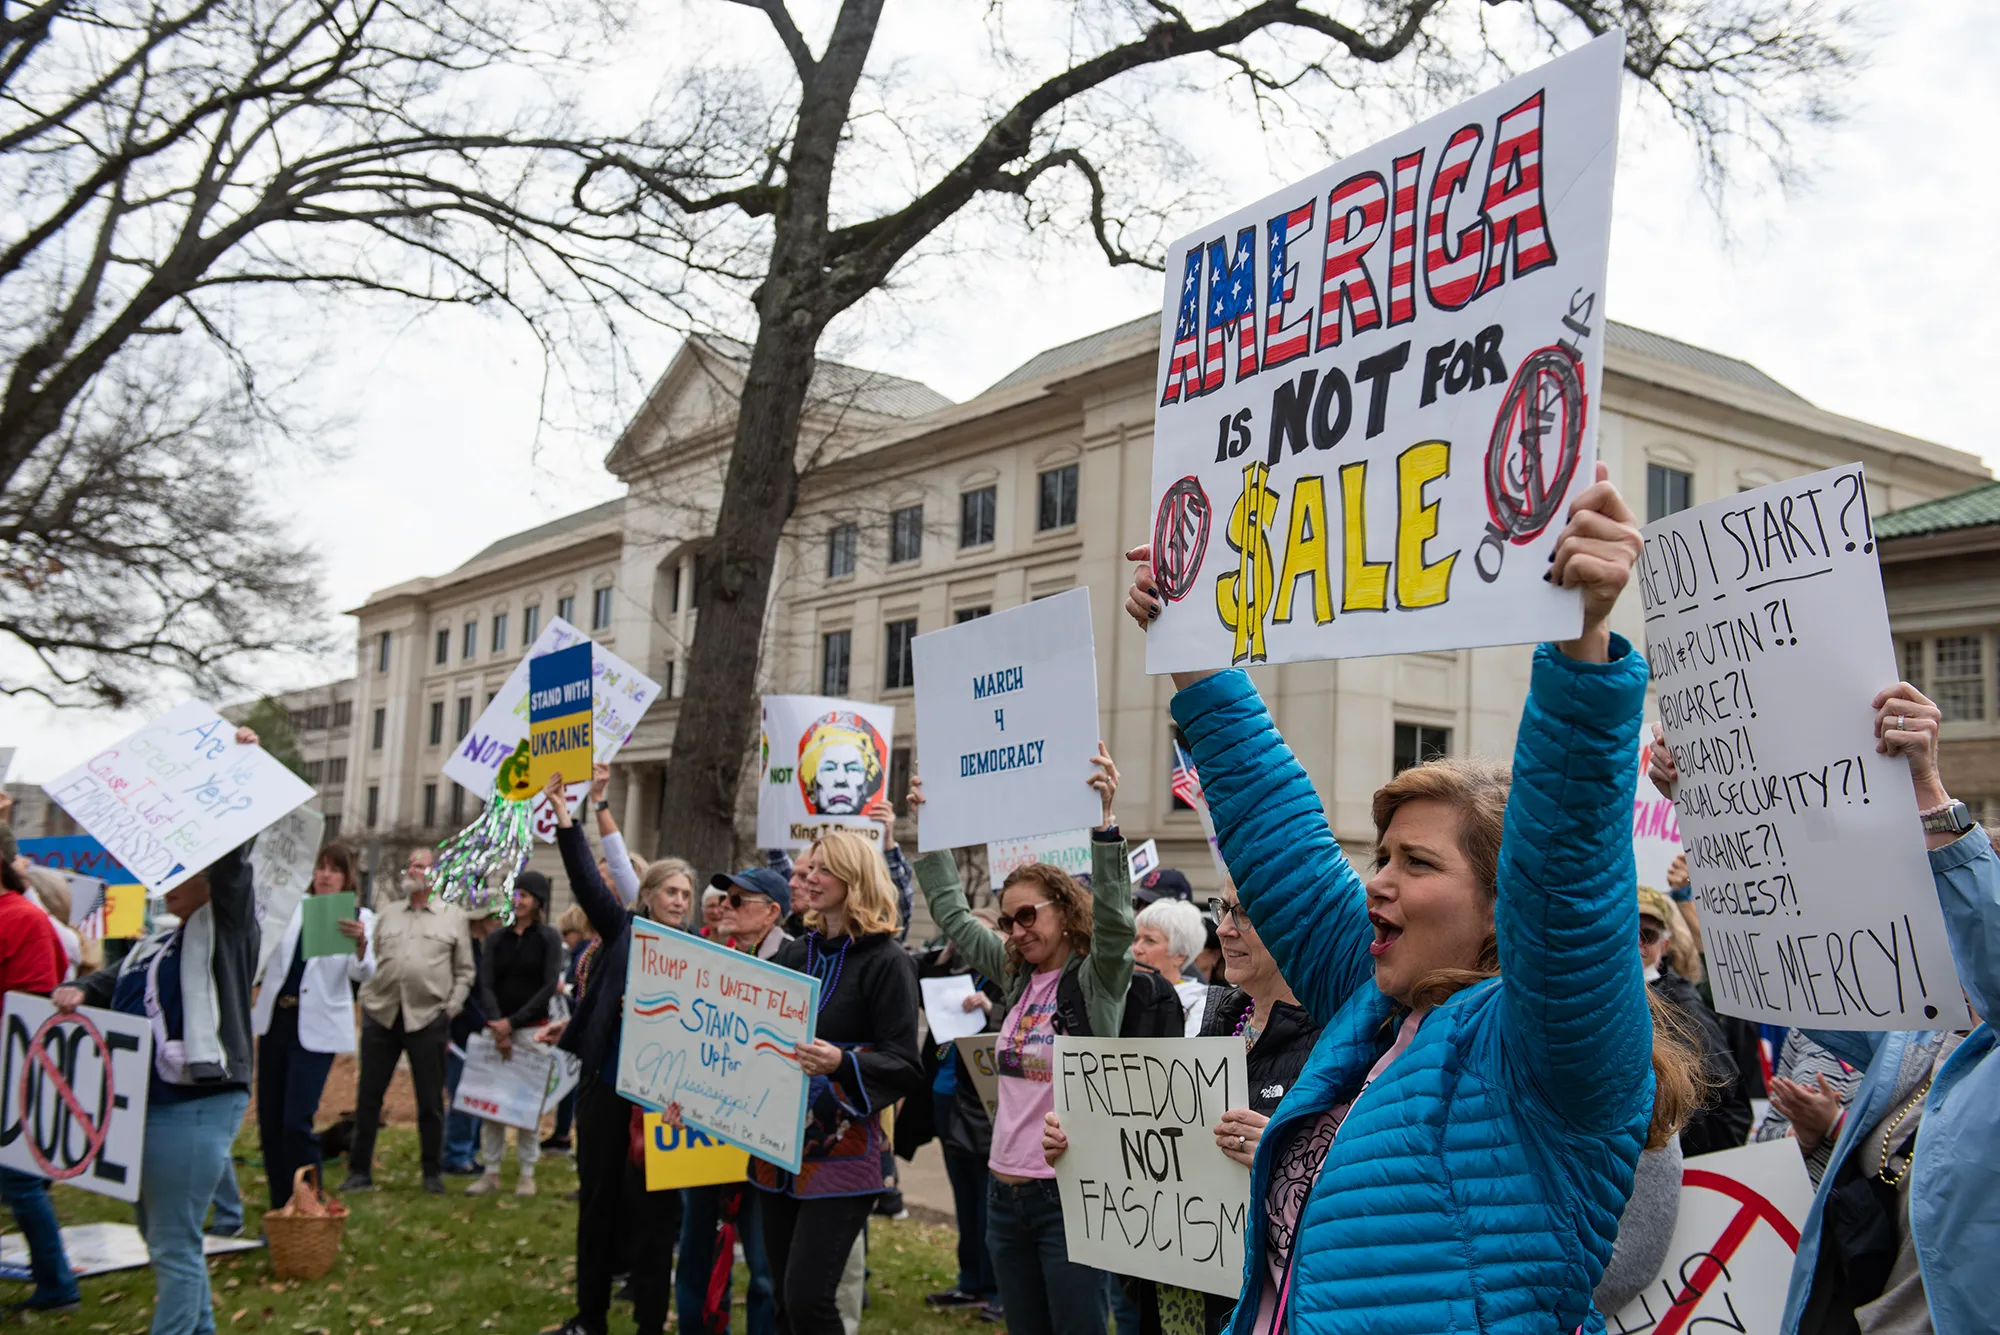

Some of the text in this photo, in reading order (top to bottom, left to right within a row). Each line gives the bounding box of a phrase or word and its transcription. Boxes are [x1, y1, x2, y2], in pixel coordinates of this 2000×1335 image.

[1160, 88, 1558, 407] AMERICA
[1215, 324, 1508, 465] IS NOT FOR
[1216, 440, 1461, 666] $ALE
[1658, 530, 1697, 599] DO
[1699, 520, 1719, 585] I
[531, 687, 562, 711] STAND
[563, 679, 590, 704] WITH
[972, 665, 1025, 700] MARCH
[177, 719, 226, 760] Are
[531, 723, 590, 757] UKRAINE
[994, 708, 1005, 732] 4
[128, 727, 252, 819] Great Yet?
[462, 732, 514, 770] NOT
[959, 739, 1045, 778] DEMOCRACY
[770, 767, 794, 785] NOT
[164, 820, 219, 859] Feel
[790, 823, 818, 842] King
[634, 934, 688, 980] TRUMP
[696, 968, 710, 989] IS
[719, 974, 763, 1006] UNFIT
[1708, 914, 1938, 1020] HAVE MERCY!
[680, 998, 749, 1045] STAND
[1025, 1070, 1053, 1083] ABOU
[1063, 1051, 1229, 1127] FREEDOM
[1120, 1126, 1183, 1183] NOT
[1080, 1179, 1246, 1267] FASCISM
